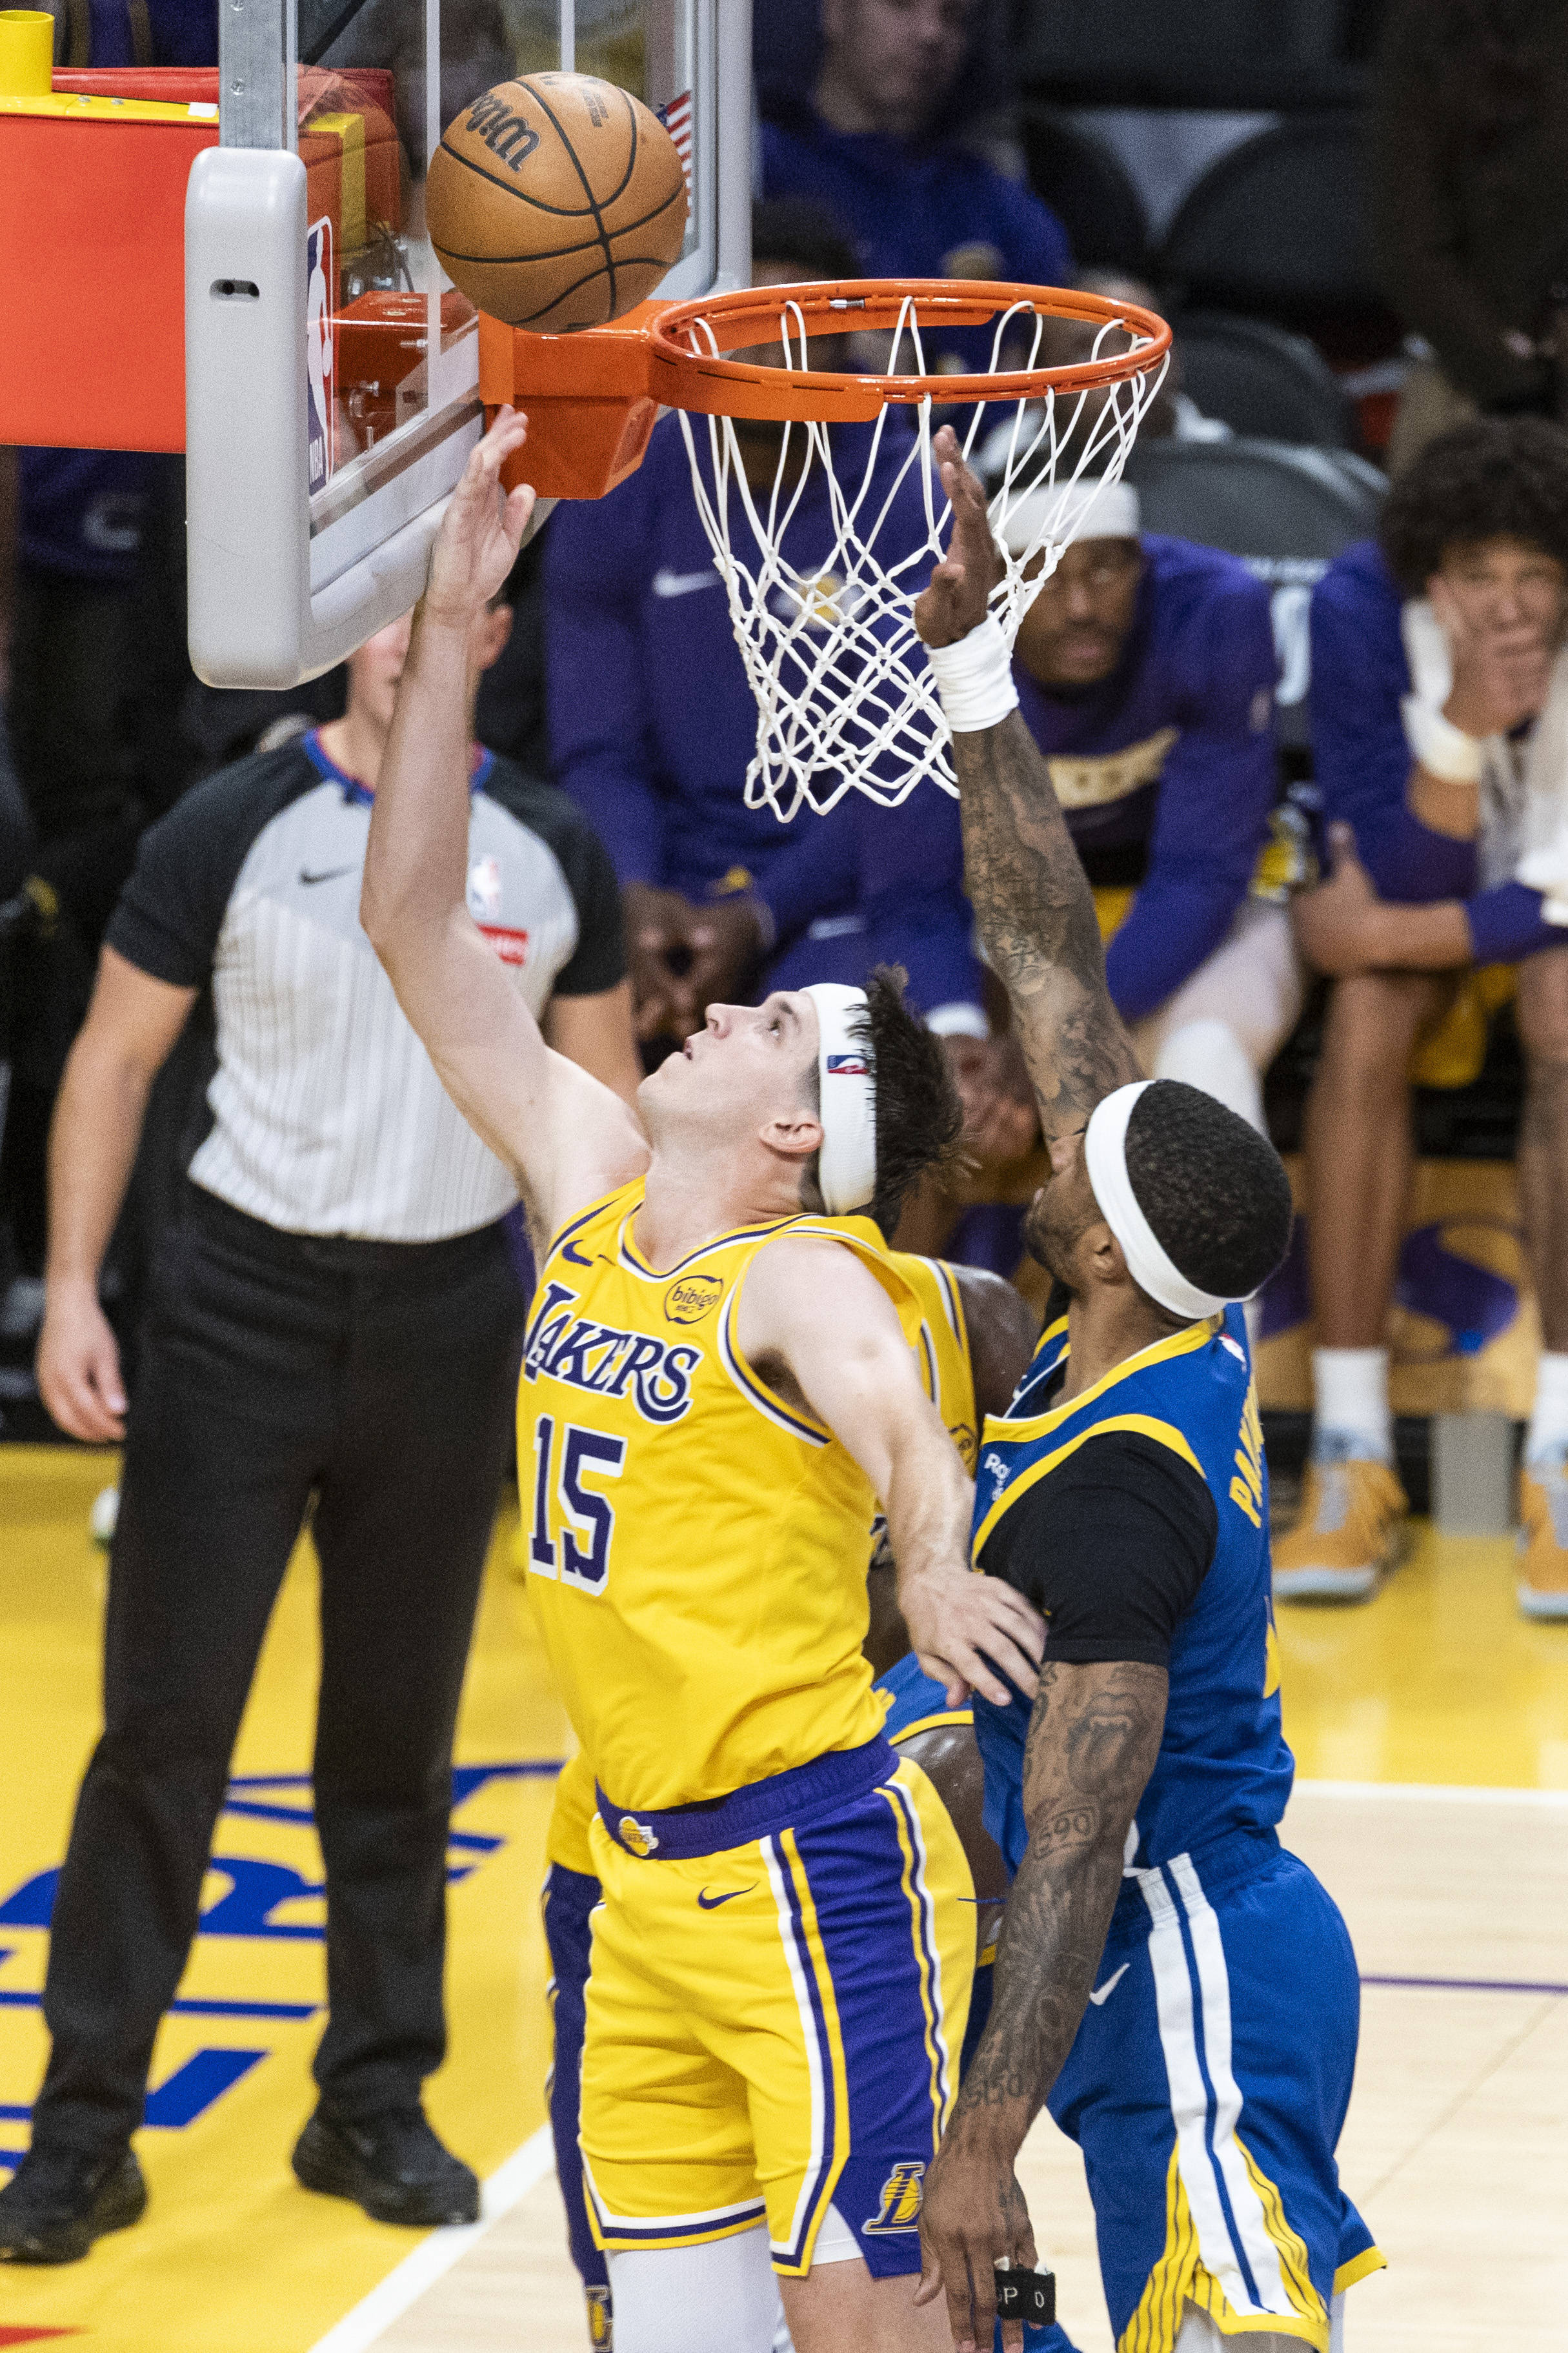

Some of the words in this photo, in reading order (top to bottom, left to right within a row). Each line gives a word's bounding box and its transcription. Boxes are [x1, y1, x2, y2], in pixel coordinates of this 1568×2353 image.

[523, 1279, 704, 1425] LAKERS
[672, 1286, 721, 1311] bibigo
[528, 1412, 628, 1597] 15
